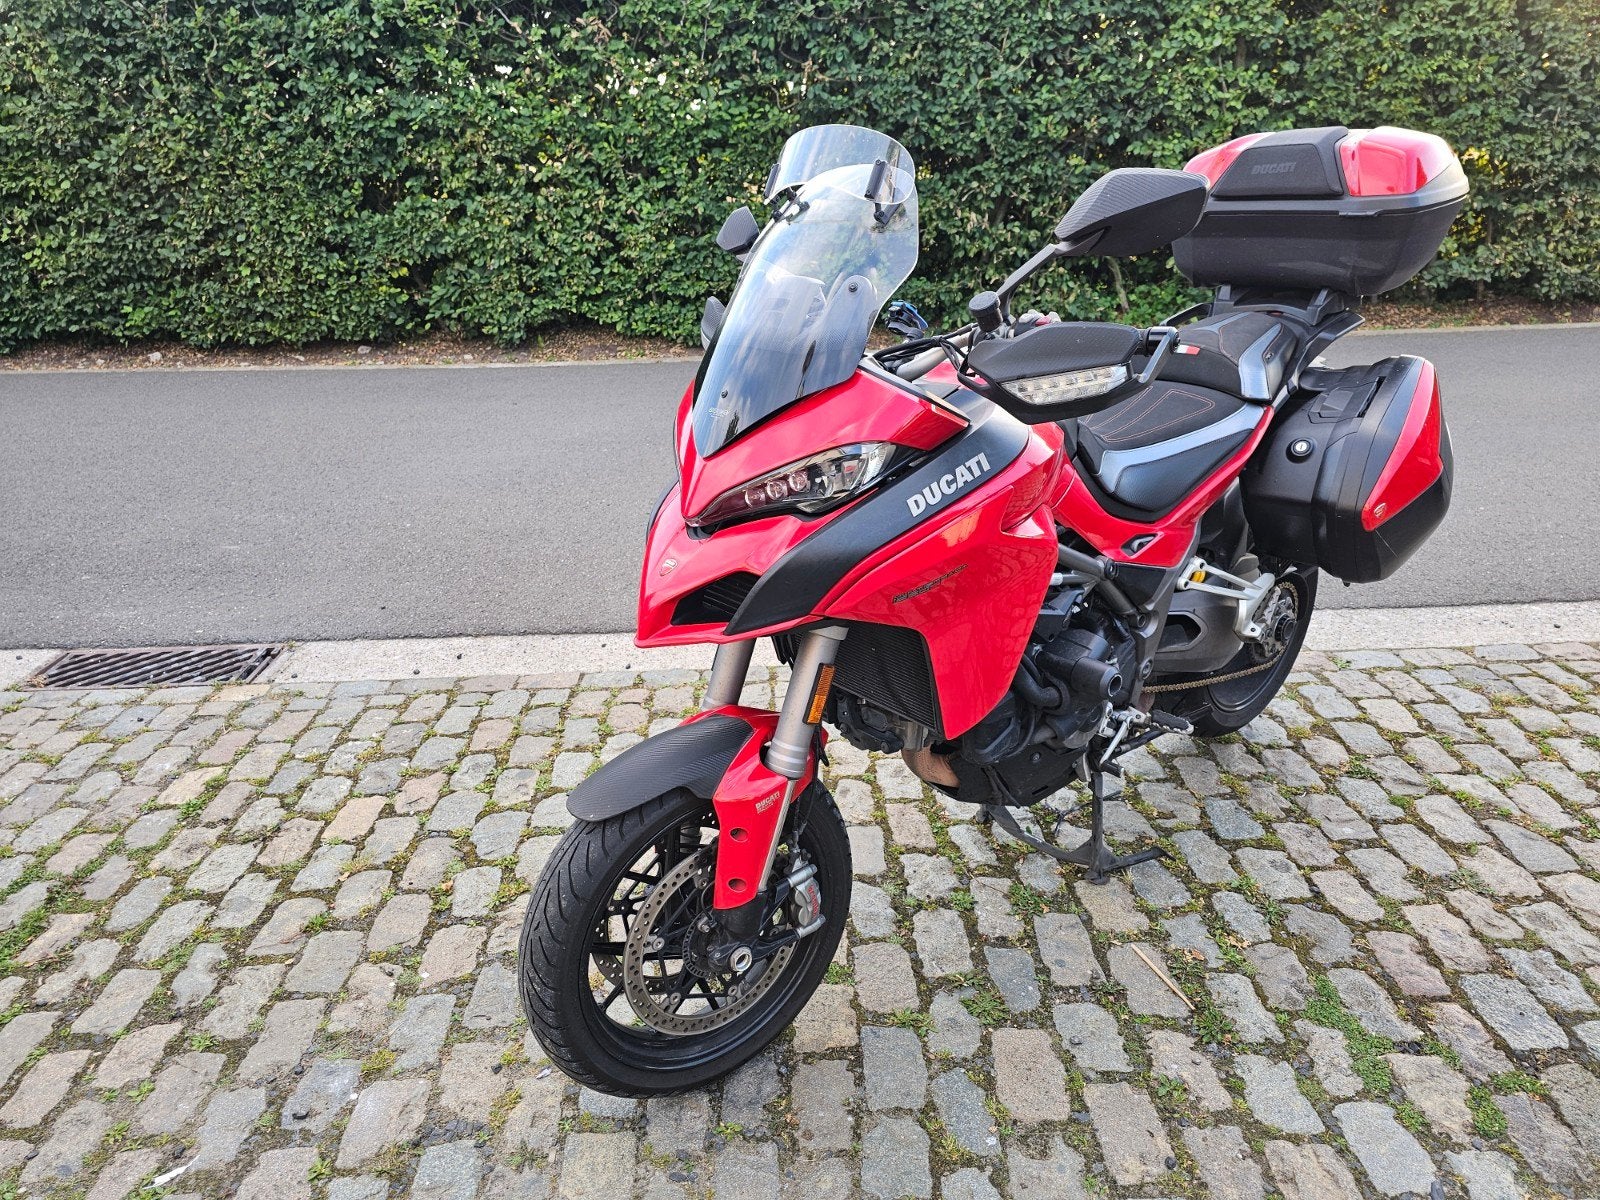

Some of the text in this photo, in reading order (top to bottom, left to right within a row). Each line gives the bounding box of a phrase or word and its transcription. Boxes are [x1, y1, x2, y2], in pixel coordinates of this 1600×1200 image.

[1251, 162, 1297, 175] DUCATI
[906, 452, 992, 518] DUCATI
[755, 791, 780, 809] DUCATI
